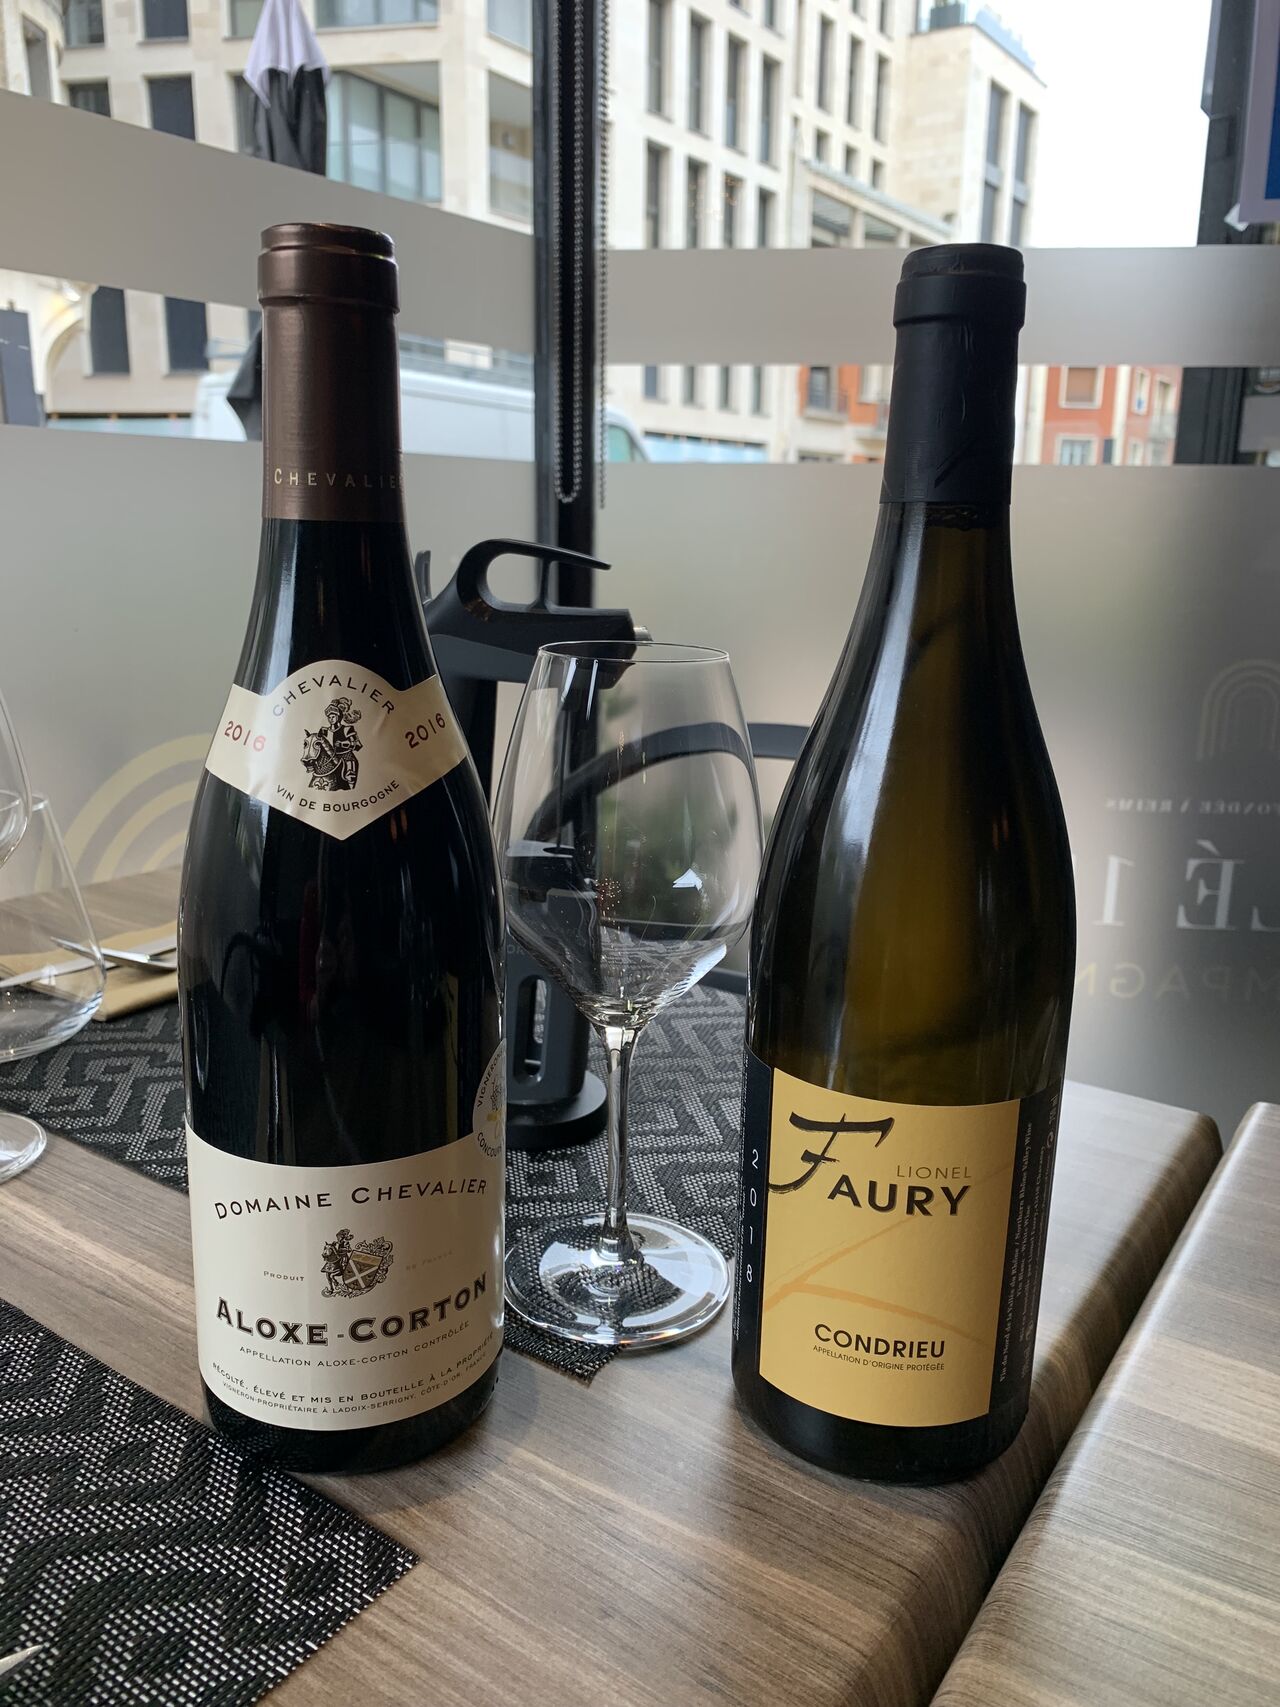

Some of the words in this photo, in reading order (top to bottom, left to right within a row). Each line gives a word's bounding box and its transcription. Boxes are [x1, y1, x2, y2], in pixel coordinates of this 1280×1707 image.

[272, 675, 395, 717] CHEVALIER
[224, 720, 266, 753] 2016
[404, 712, 446, 749] 2016
[276, 785, 295, 802] VIN
[299, 798, 317, 810] DE
[322, 780, 400, 813] BOURGOGNE
[896, 1165, 972, 1179] LIONEL
[215, 1192, 333, 1219] DOMAINE
[351, 1178, 487, 1205] CHEVALIER
[746, 1148, 759, 1283] 2018
[263, 1271, 305, 1282] PRODUIT
[239, 1346, 311, 1366] APPELLATION
[317, 1349, 408, 1367] ALOXE-CORTON
[414, 1320, 470, 1352] CONTRÔLÉE
[813, 1345, 861, 1365] APPELLATION
[862, 1358, 904, 1371] D'ORIGINE
[906, 1363, 945, 1371] PROTÉGÉE
[814, 1323, 945, 1359] CONDRIEU
[253, 1385, 286, 1400] ÉLEVÉ
[310, 1396, 332, 1404] MIS
[338, 1395, 354, 1403] EN
[361, 1379, 424, 1401] BOUTEILLE
[429, 1374, 436, 1382] À
[440, 1367, 453, 1378] LA
[456, 1331, 494, 1368] PROPRIÉTÉ
[322, 1406, 329, 1414] À
